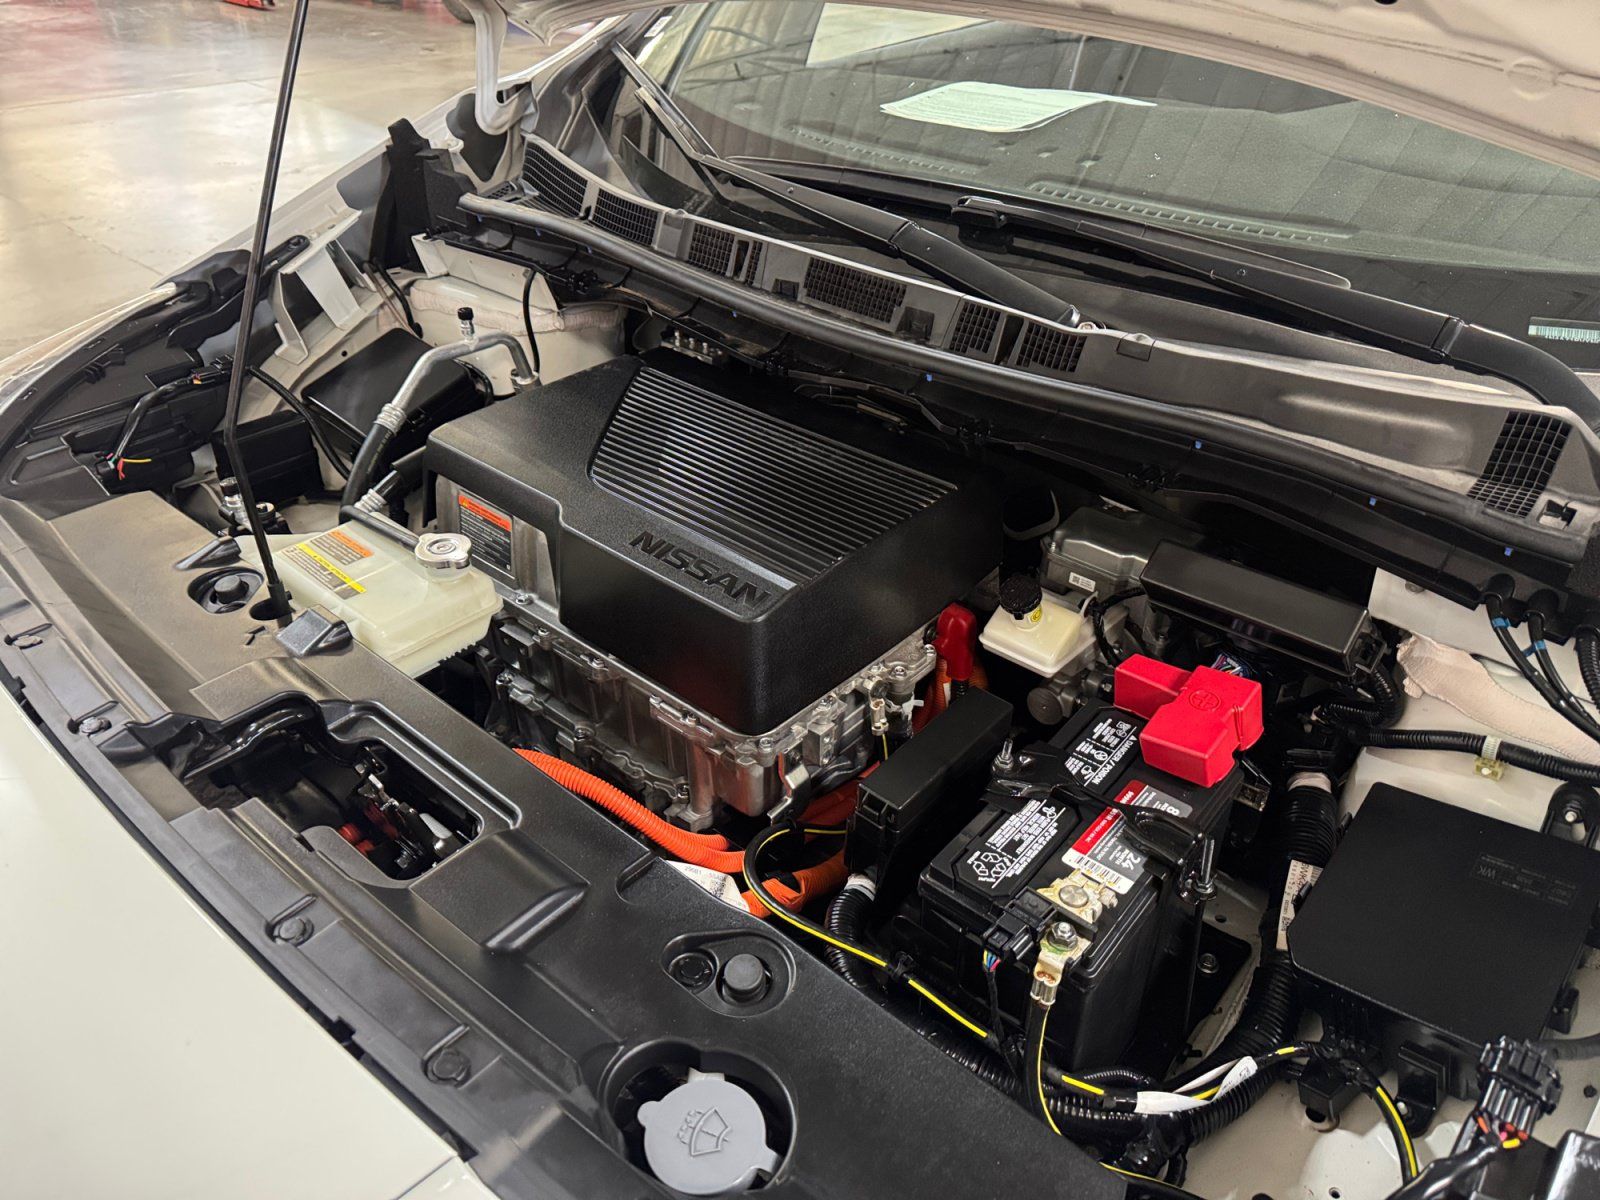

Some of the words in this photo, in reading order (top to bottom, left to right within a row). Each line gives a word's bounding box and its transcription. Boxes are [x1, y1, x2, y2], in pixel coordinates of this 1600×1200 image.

[629, 531, 772, 609] NISSAN
[1111, 740, 1134, 762] DANGER
[1091, 763, 1113, 785] POISON
[1121, 853, 1141, 870] 24
